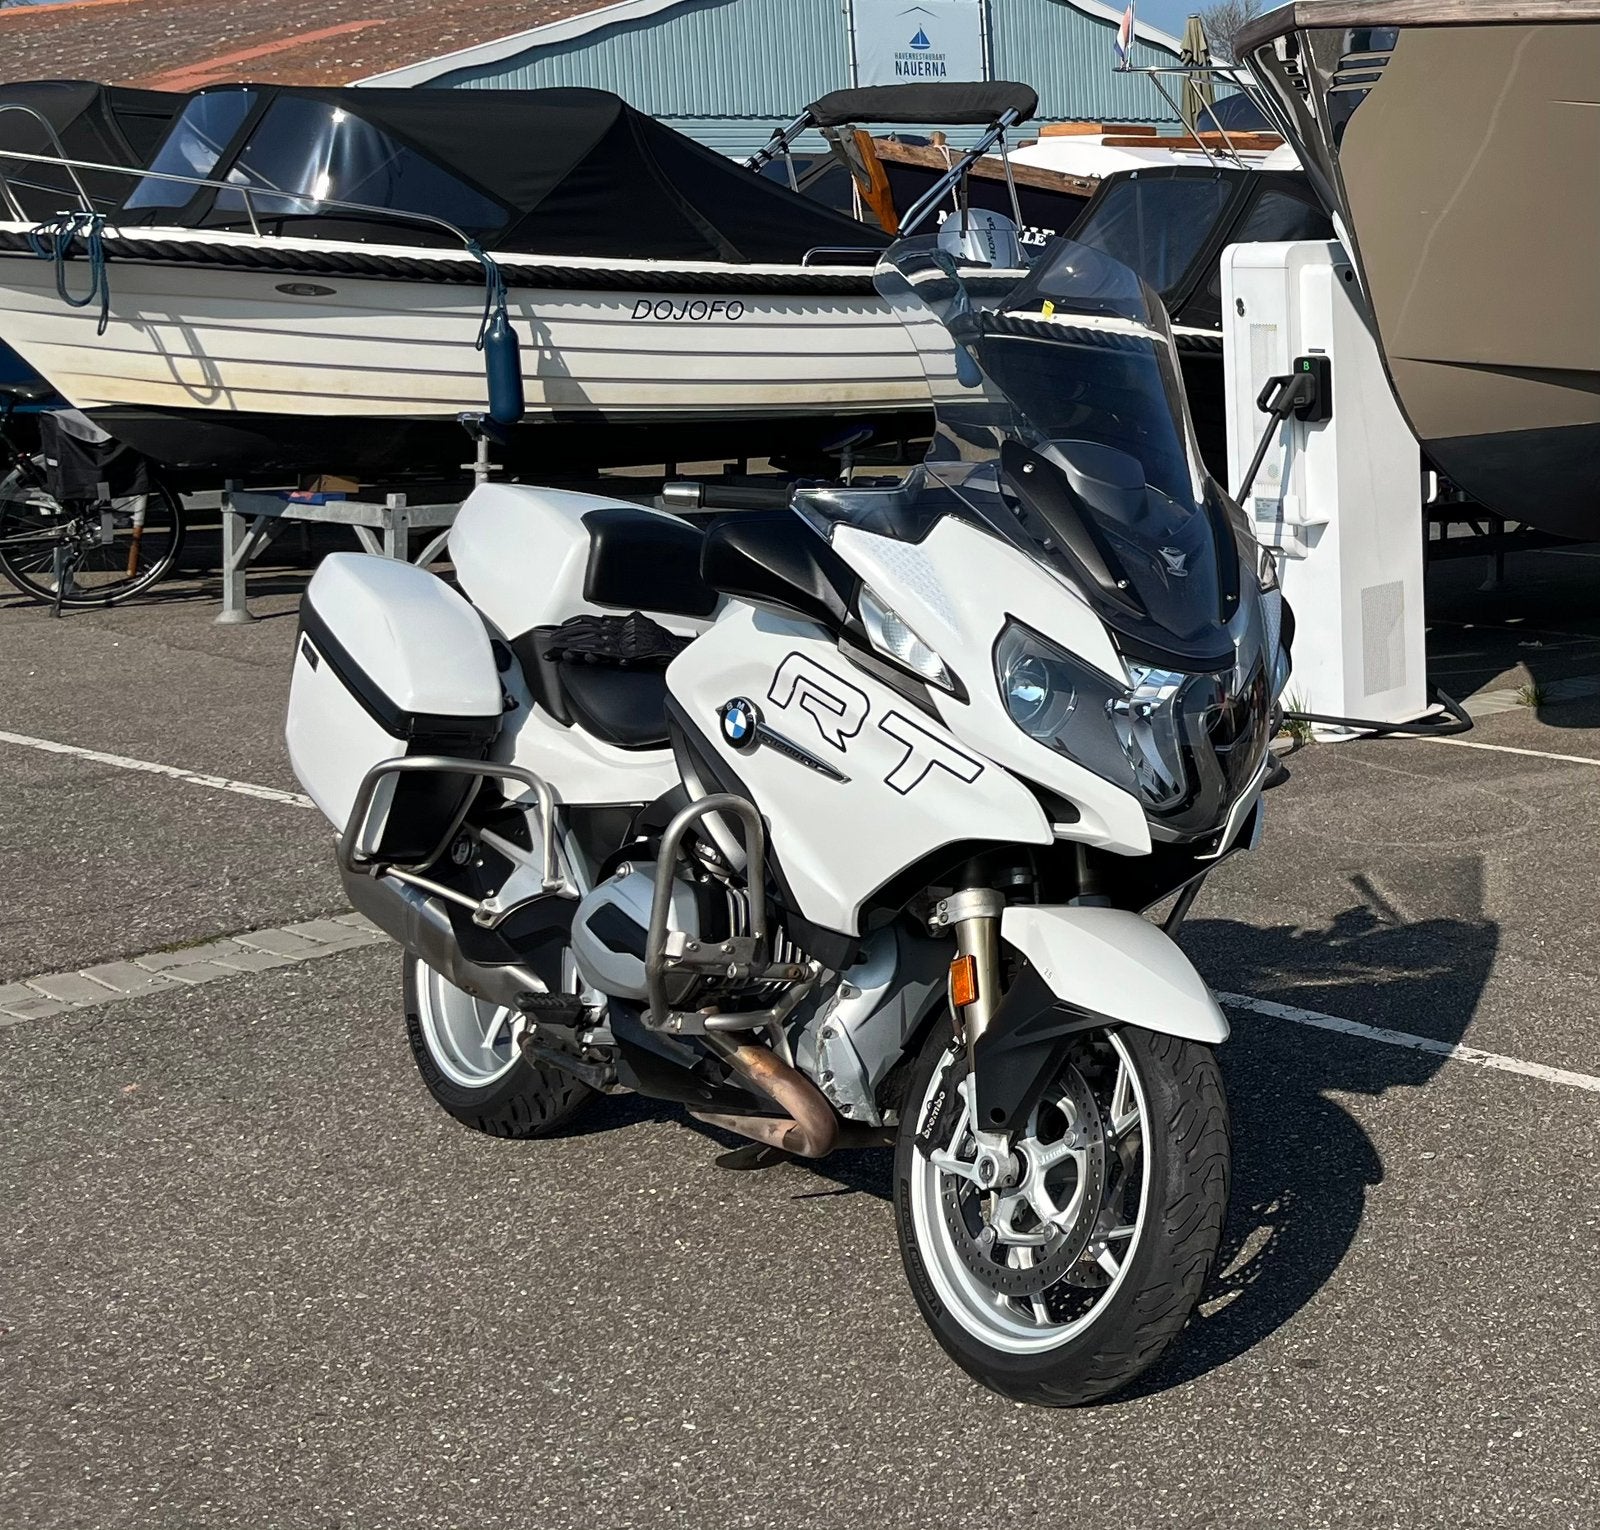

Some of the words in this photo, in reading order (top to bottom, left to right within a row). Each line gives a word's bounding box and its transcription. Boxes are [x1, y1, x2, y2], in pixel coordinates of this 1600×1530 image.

[895, 61, 947, 77] NAUERNA
[986, 216, 997, 261] HONDA
[631, 299, 744, 321] DOJOFO
[1303, 361, 1310, 371] B
[767, 651, 985, 796] RT
[922, 1091, 946, 1140] brembo
